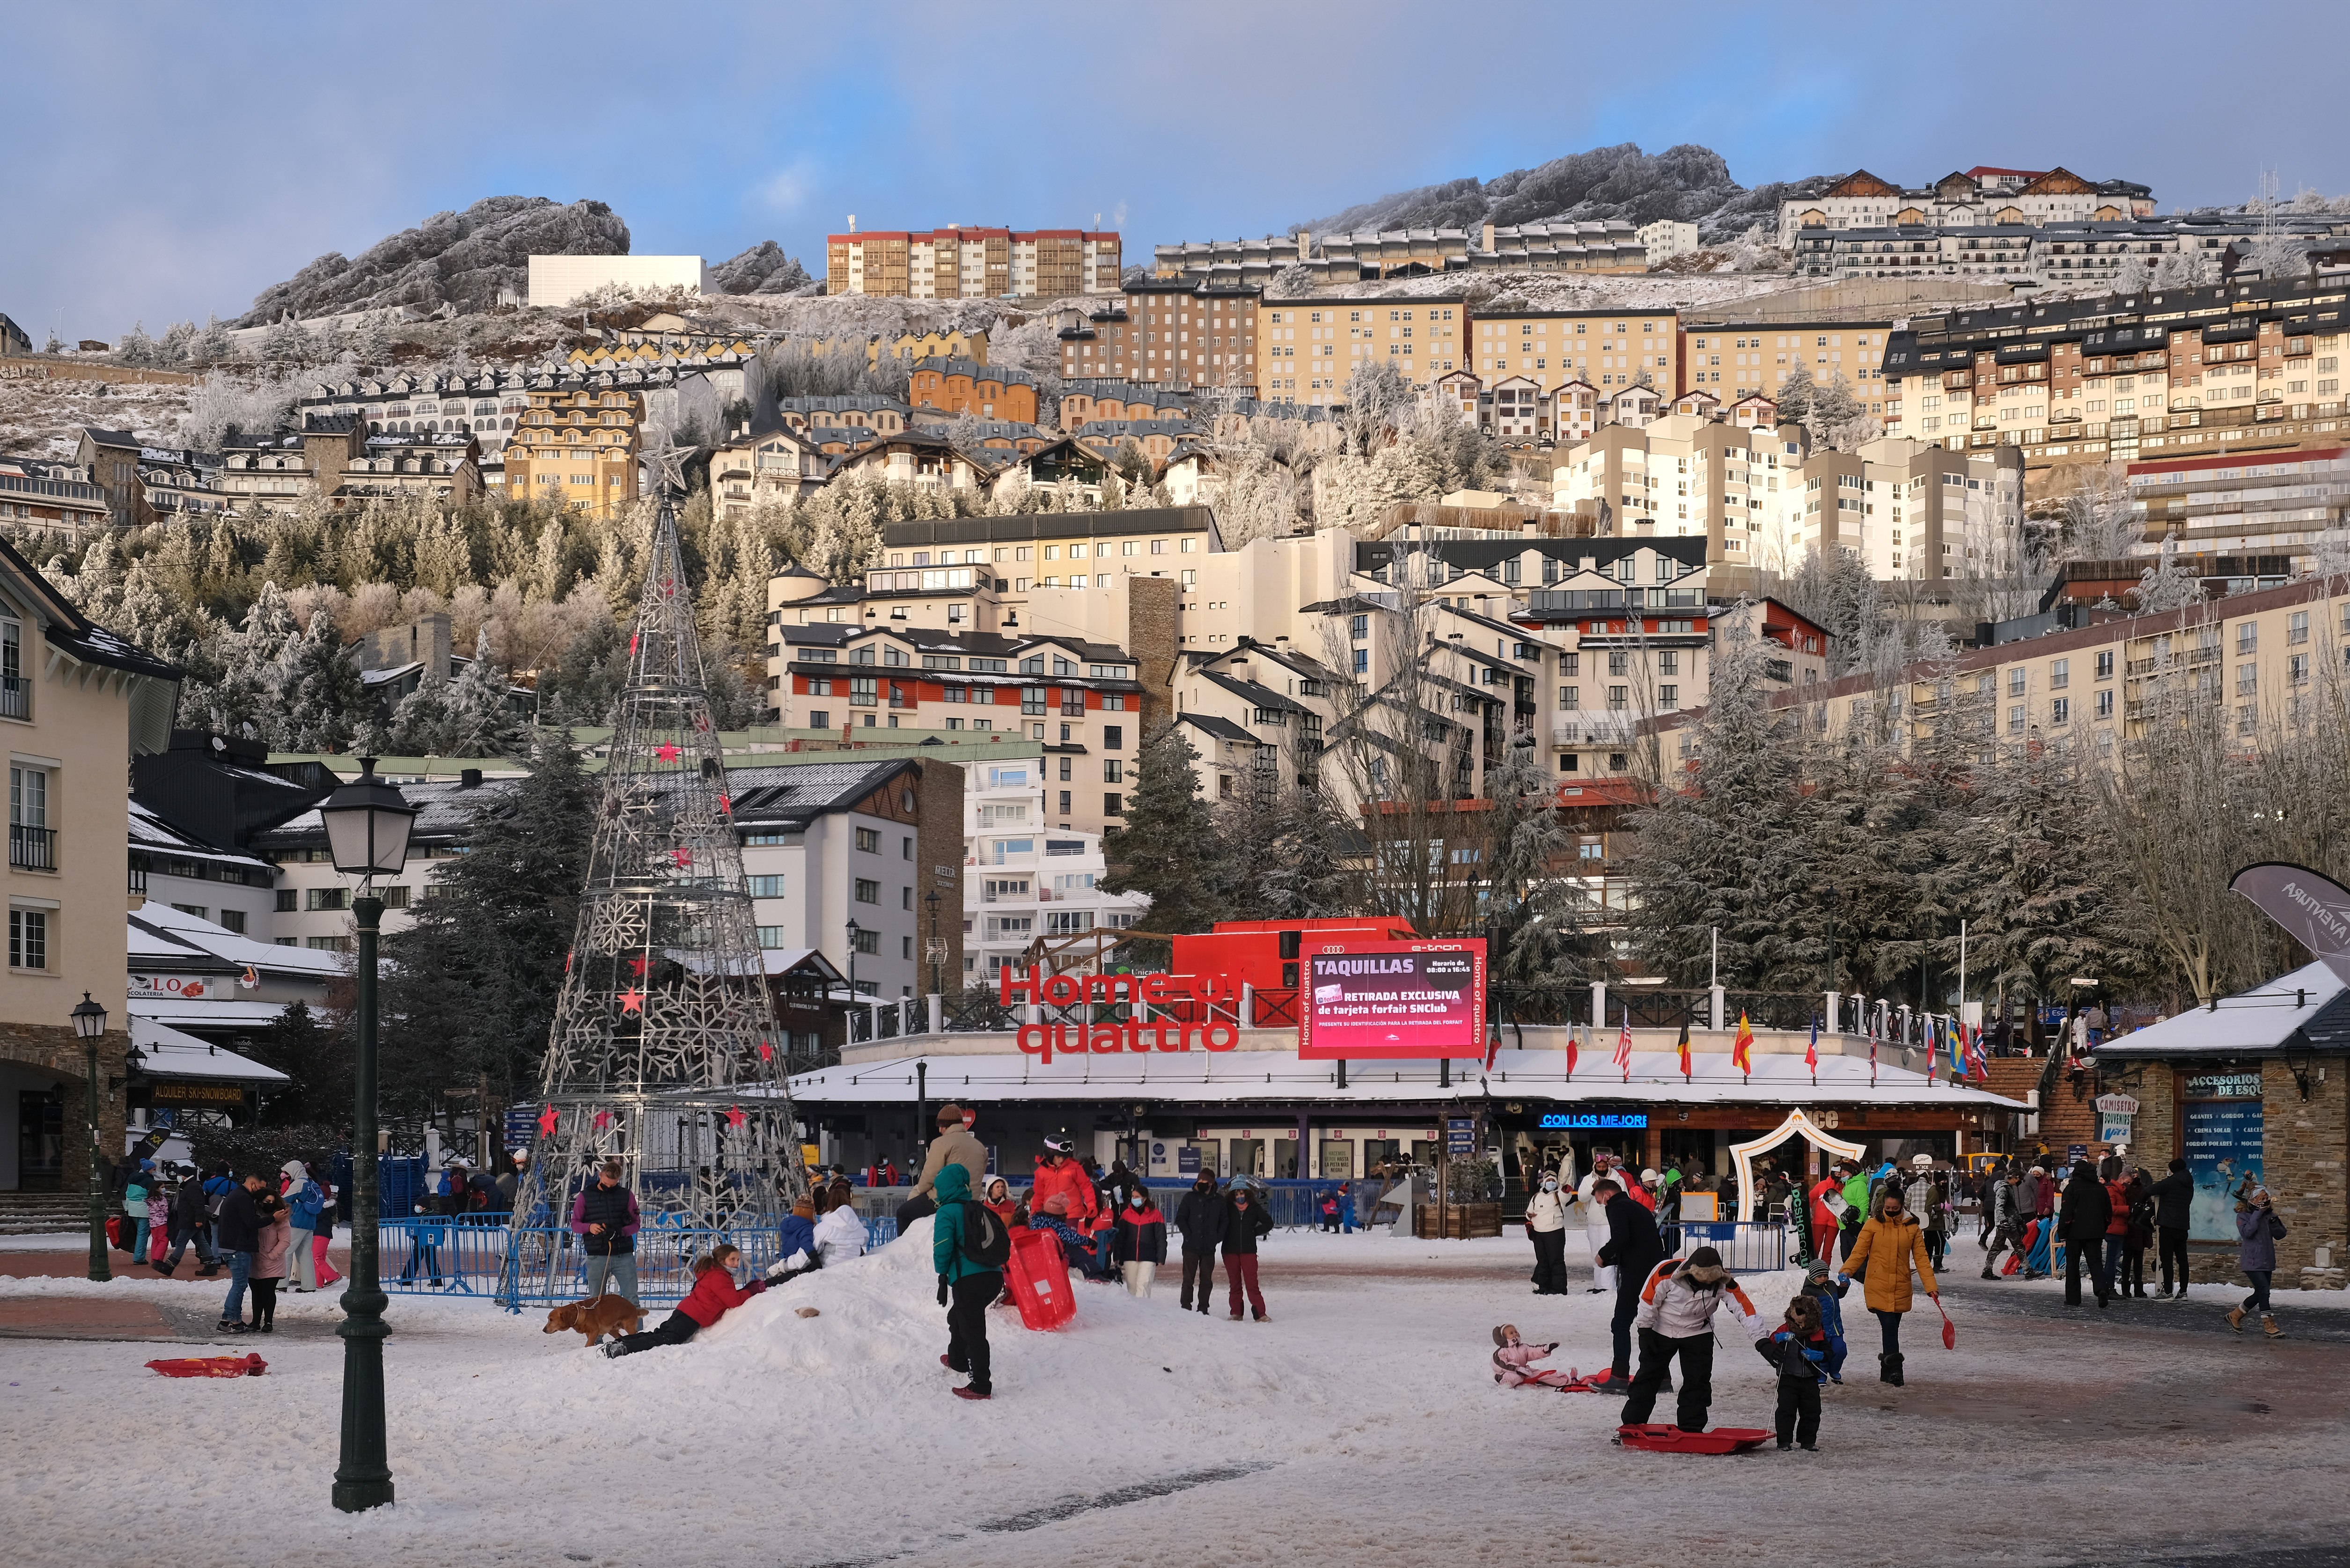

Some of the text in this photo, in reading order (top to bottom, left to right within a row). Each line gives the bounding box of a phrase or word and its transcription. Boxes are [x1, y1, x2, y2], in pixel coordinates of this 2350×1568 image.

[1315, 959, 1414, 977] TAQUILLAS
[1000, 965, 1245, 1006] Home of
[1324, 994, 1342, 1003] forfait
[1344, 990, 1460, 1002] RETIRADA EXCLUSIVA
[1475, 990, 1482, 1002] of
[1303, 1001, 1309, 1012] of
[1318, 1003, 1447, 1017] de tarjeta forfait SNClub
[1016, 1015, 1240, 1065] quattro
[2191, 1074, 2260, 1086] ACCESORIOS
[155, 1085, 242, 1100] ALQUILER SKI-SNOWBOARD
[2218, 1085, 2233, 1096] DE
[2100, 1099, 2136, 1113] CAMISETAS
[1542, 1114, 1570, 1125] CON
[1573, 1114, 1598, 1125] LOS
[2104, 1113, 2130, 1125] SOUVENIRS
